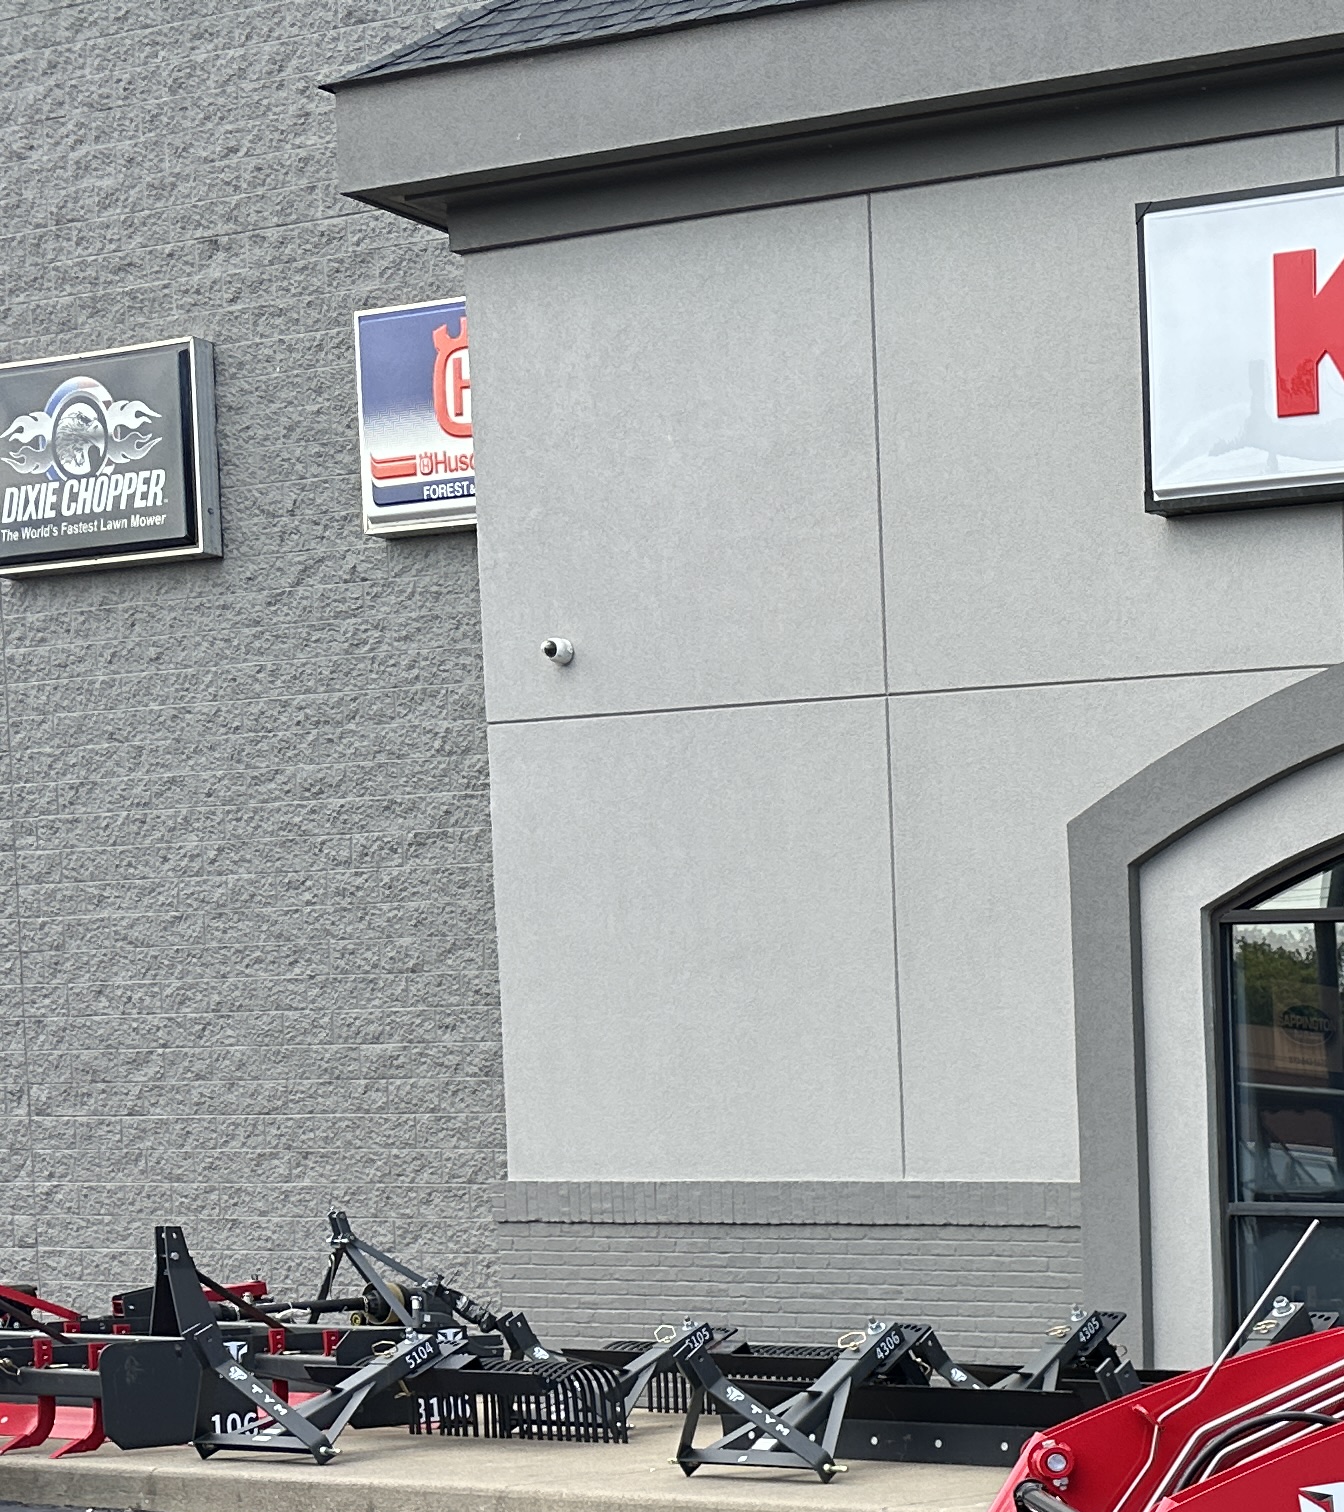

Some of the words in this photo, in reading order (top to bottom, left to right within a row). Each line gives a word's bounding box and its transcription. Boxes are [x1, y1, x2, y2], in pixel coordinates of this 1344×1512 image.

[2, 481, 59, 523] DIXIE
[61, 469, 166, 517] CHOPPER
[423, 481, 469, 500] FOREST
[1, 529, 19, 542] The
[22, 524, 58, 540] World's
[61, 518, 98, 536] Fastest
[100, 517, 128, 531] Lawn
[131, 513, 166, 528] Mower
[405, 1341, 434, 1369] 5104
[875, 1332, 900, 1360] 4306
[251, 1384, 287, 1415] TYM
[750, 1403, 790, 1437] TYM
